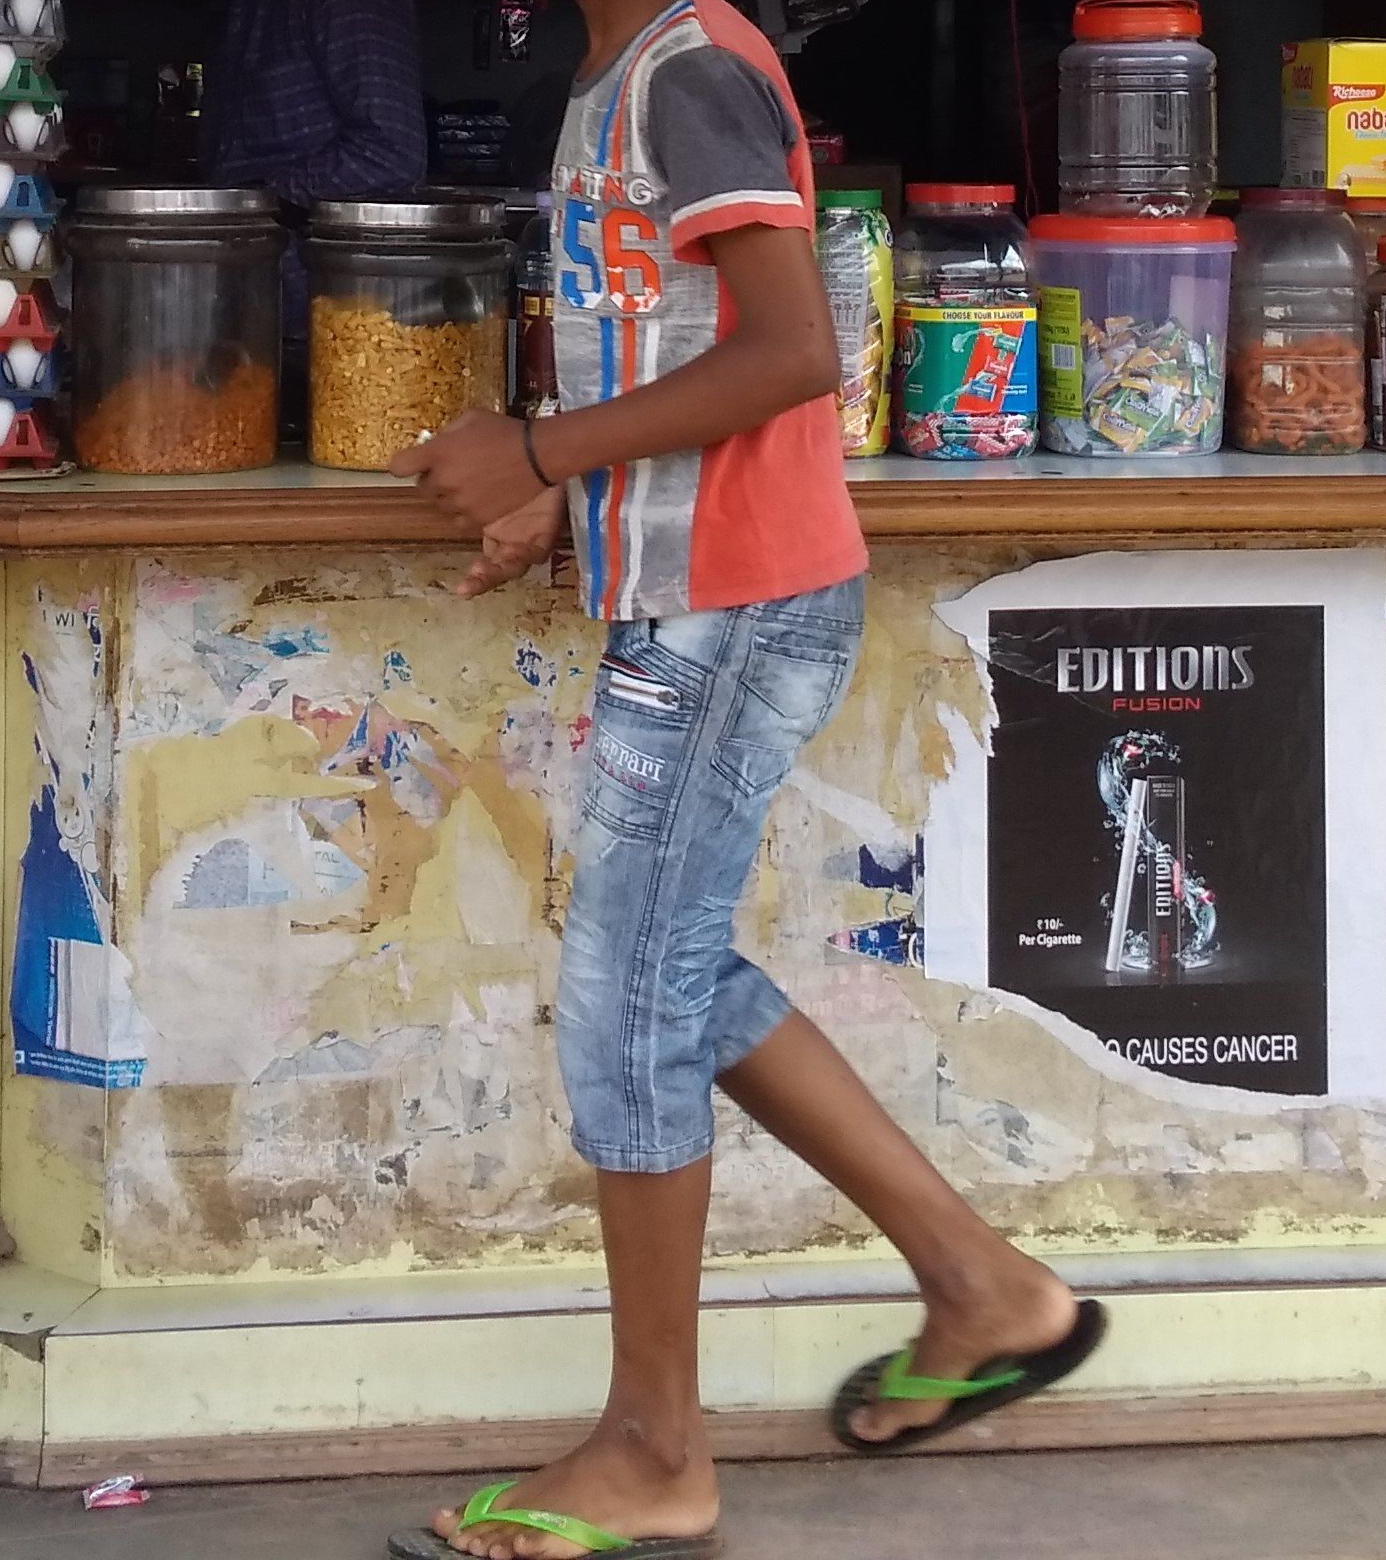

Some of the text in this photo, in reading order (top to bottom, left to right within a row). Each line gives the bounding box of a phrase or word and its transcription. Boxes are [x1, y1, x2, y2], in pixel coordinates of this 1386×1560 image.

[1332, 85, 1378, 100] Richeese
[942, 309, 1025, 320] CHOOSE YOUR FLAVOUR
[1057, 644, 1254, 692] EDITIONS
[1112, 697, 1202, 712] FUSION
[1155, 842, 1172, 917] EDITIONS
[1035, 918, 1064, 932] ₹10/-
[1018, 932, 1083, 949] Per Cigarette
[1125, 1036, 1210, 1066] CAUSES
[1212, 1033, 1302, 1062] CANCER
